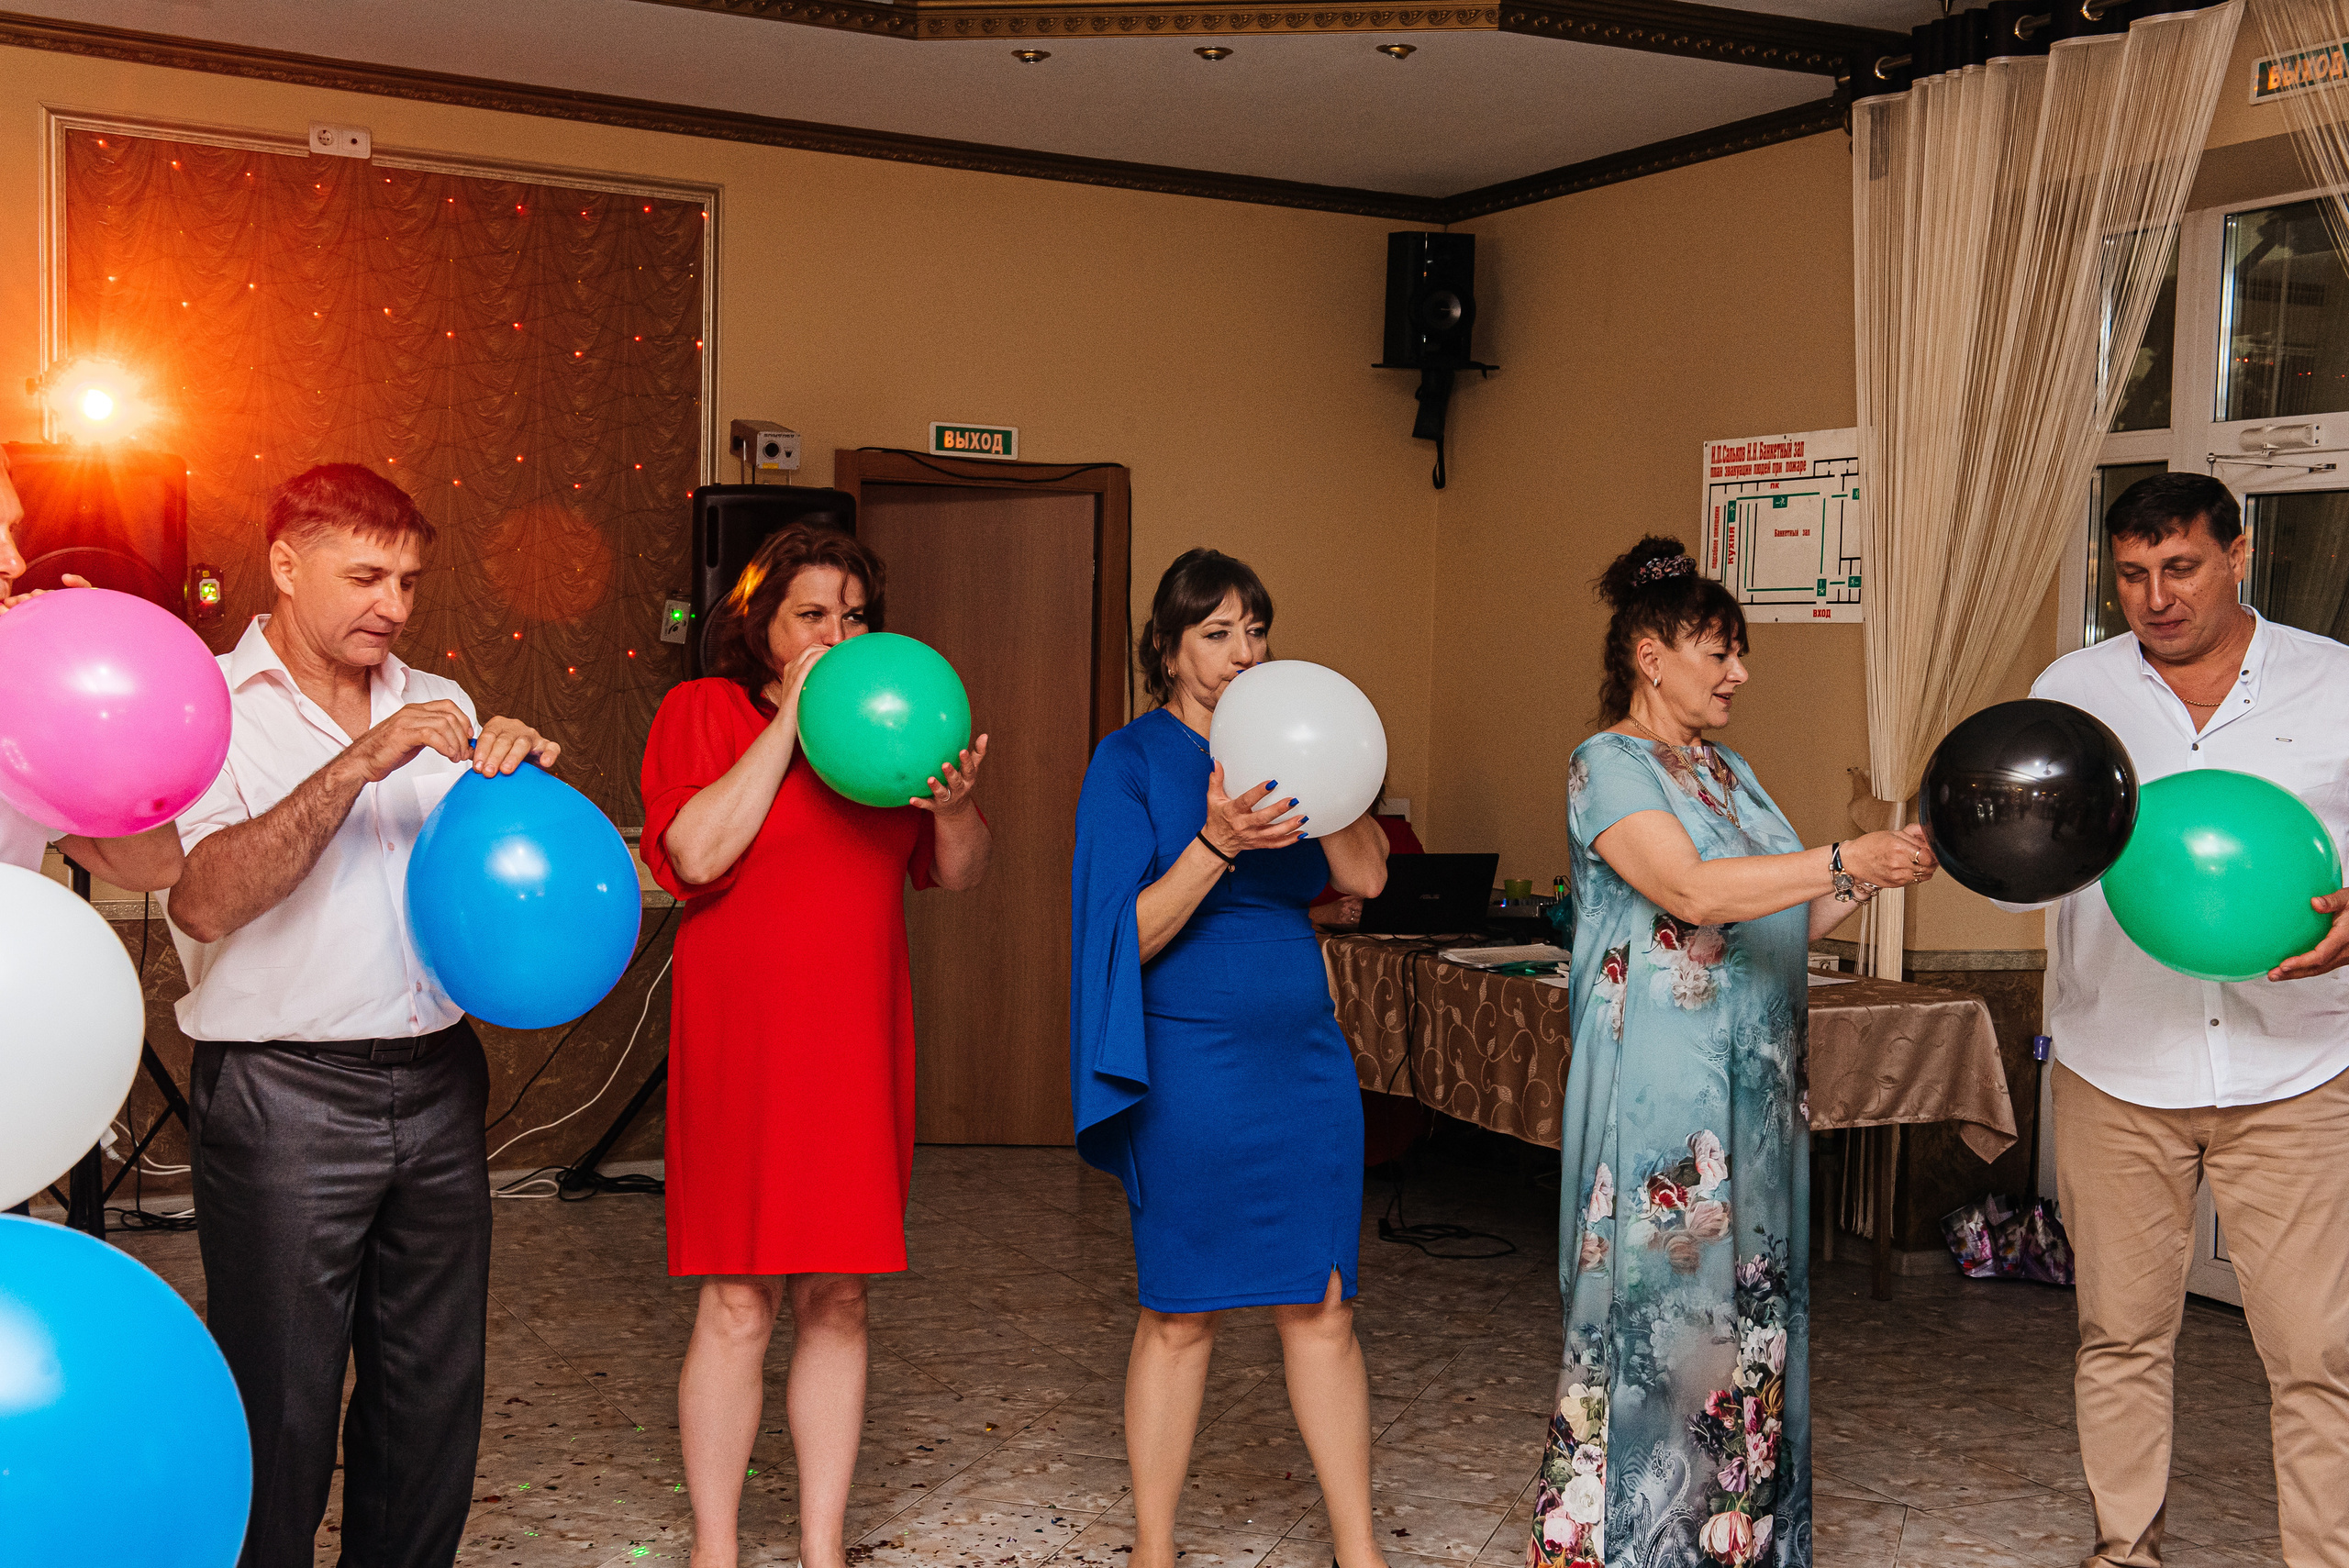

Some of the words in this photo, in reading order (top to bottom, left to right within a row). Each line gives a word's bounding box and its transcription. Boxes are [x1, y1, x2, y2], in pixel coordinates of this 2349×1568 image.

[2267, 51, 2343, 90] ВЫХОД
[944, 430, 1003, 455] ВЫХОД
[1794, 441, 1805, 458] зал
[1772, 462, 1783, 476] при
[1786, 460, 1807, 475] пожаре
[1812, 609, 1831, 618] ВХОД
